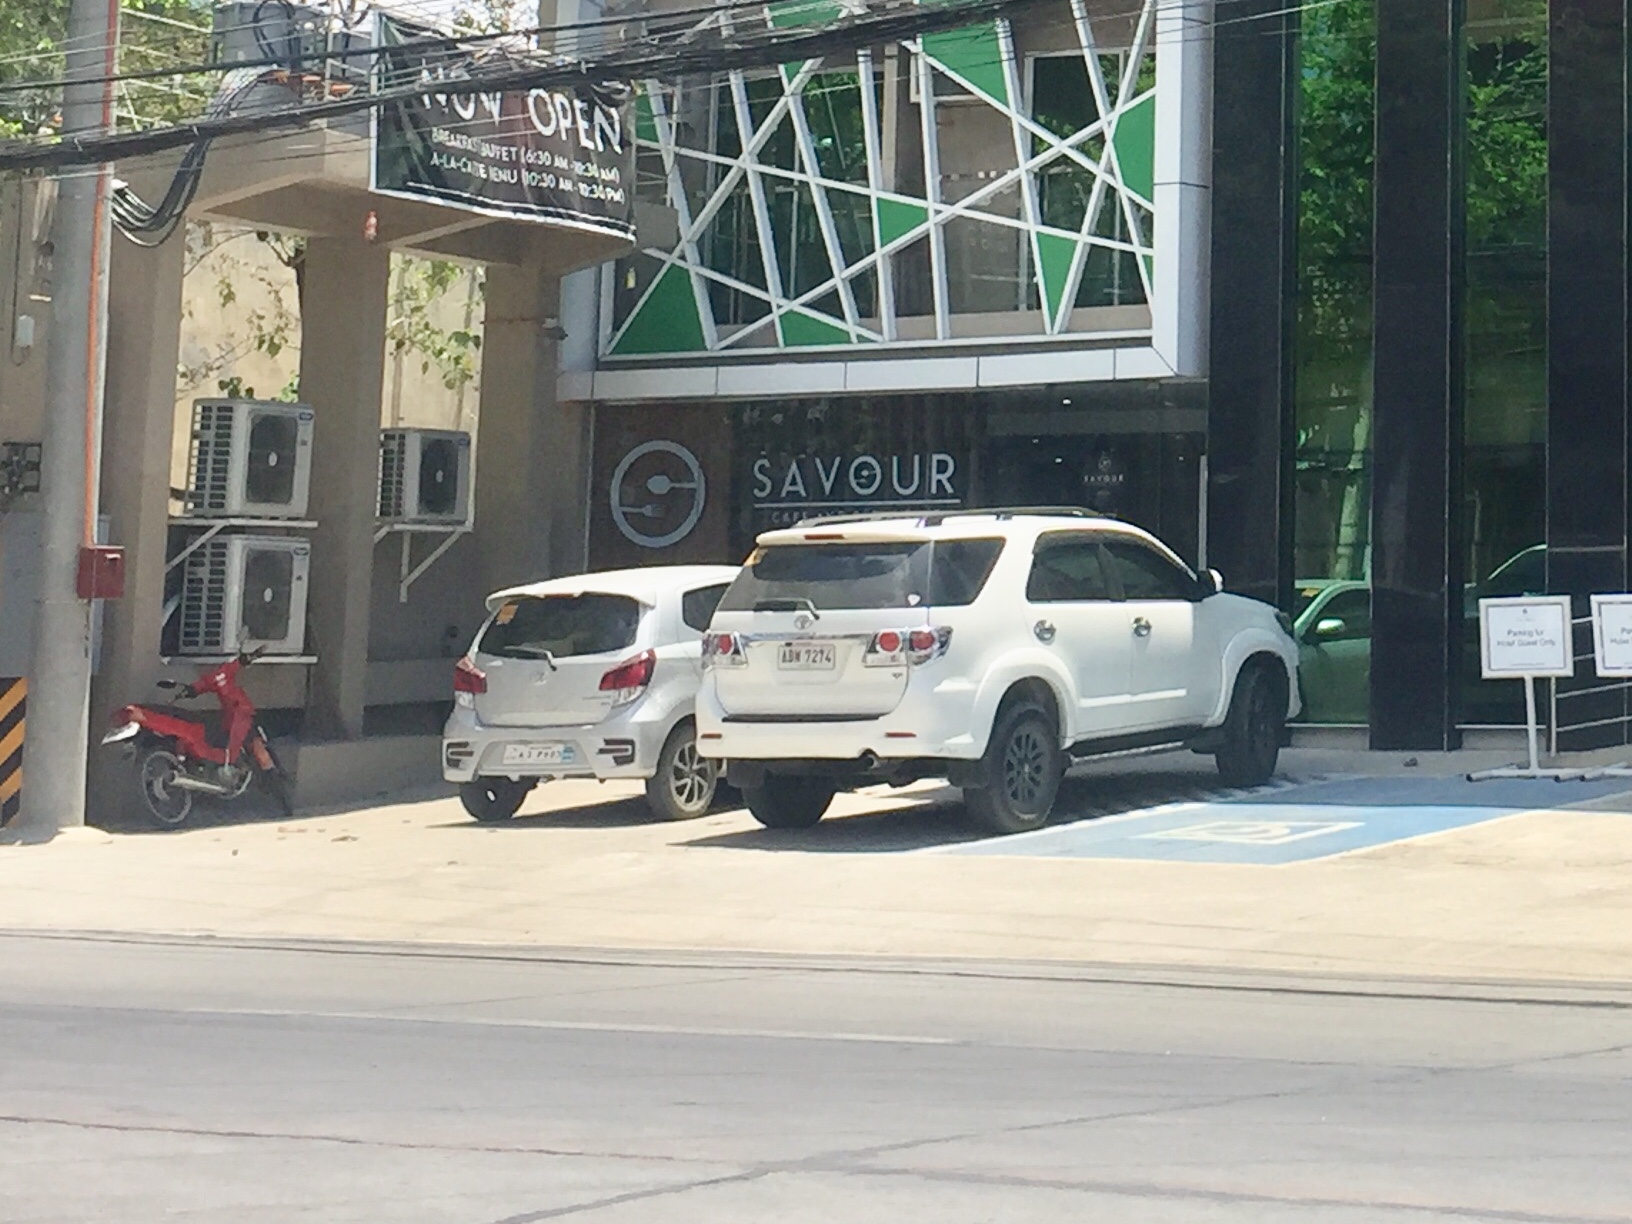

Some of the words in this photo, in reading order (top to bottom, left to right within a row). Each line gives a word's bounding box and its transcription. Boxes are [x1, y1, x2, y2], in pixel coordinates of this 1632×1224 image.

[527, 87, 623, 155] OPEN
[554, 154, 568, 170] AM
[559, 176, 573, 192] AM
[753, 452, 956, 499] SAVOUR
